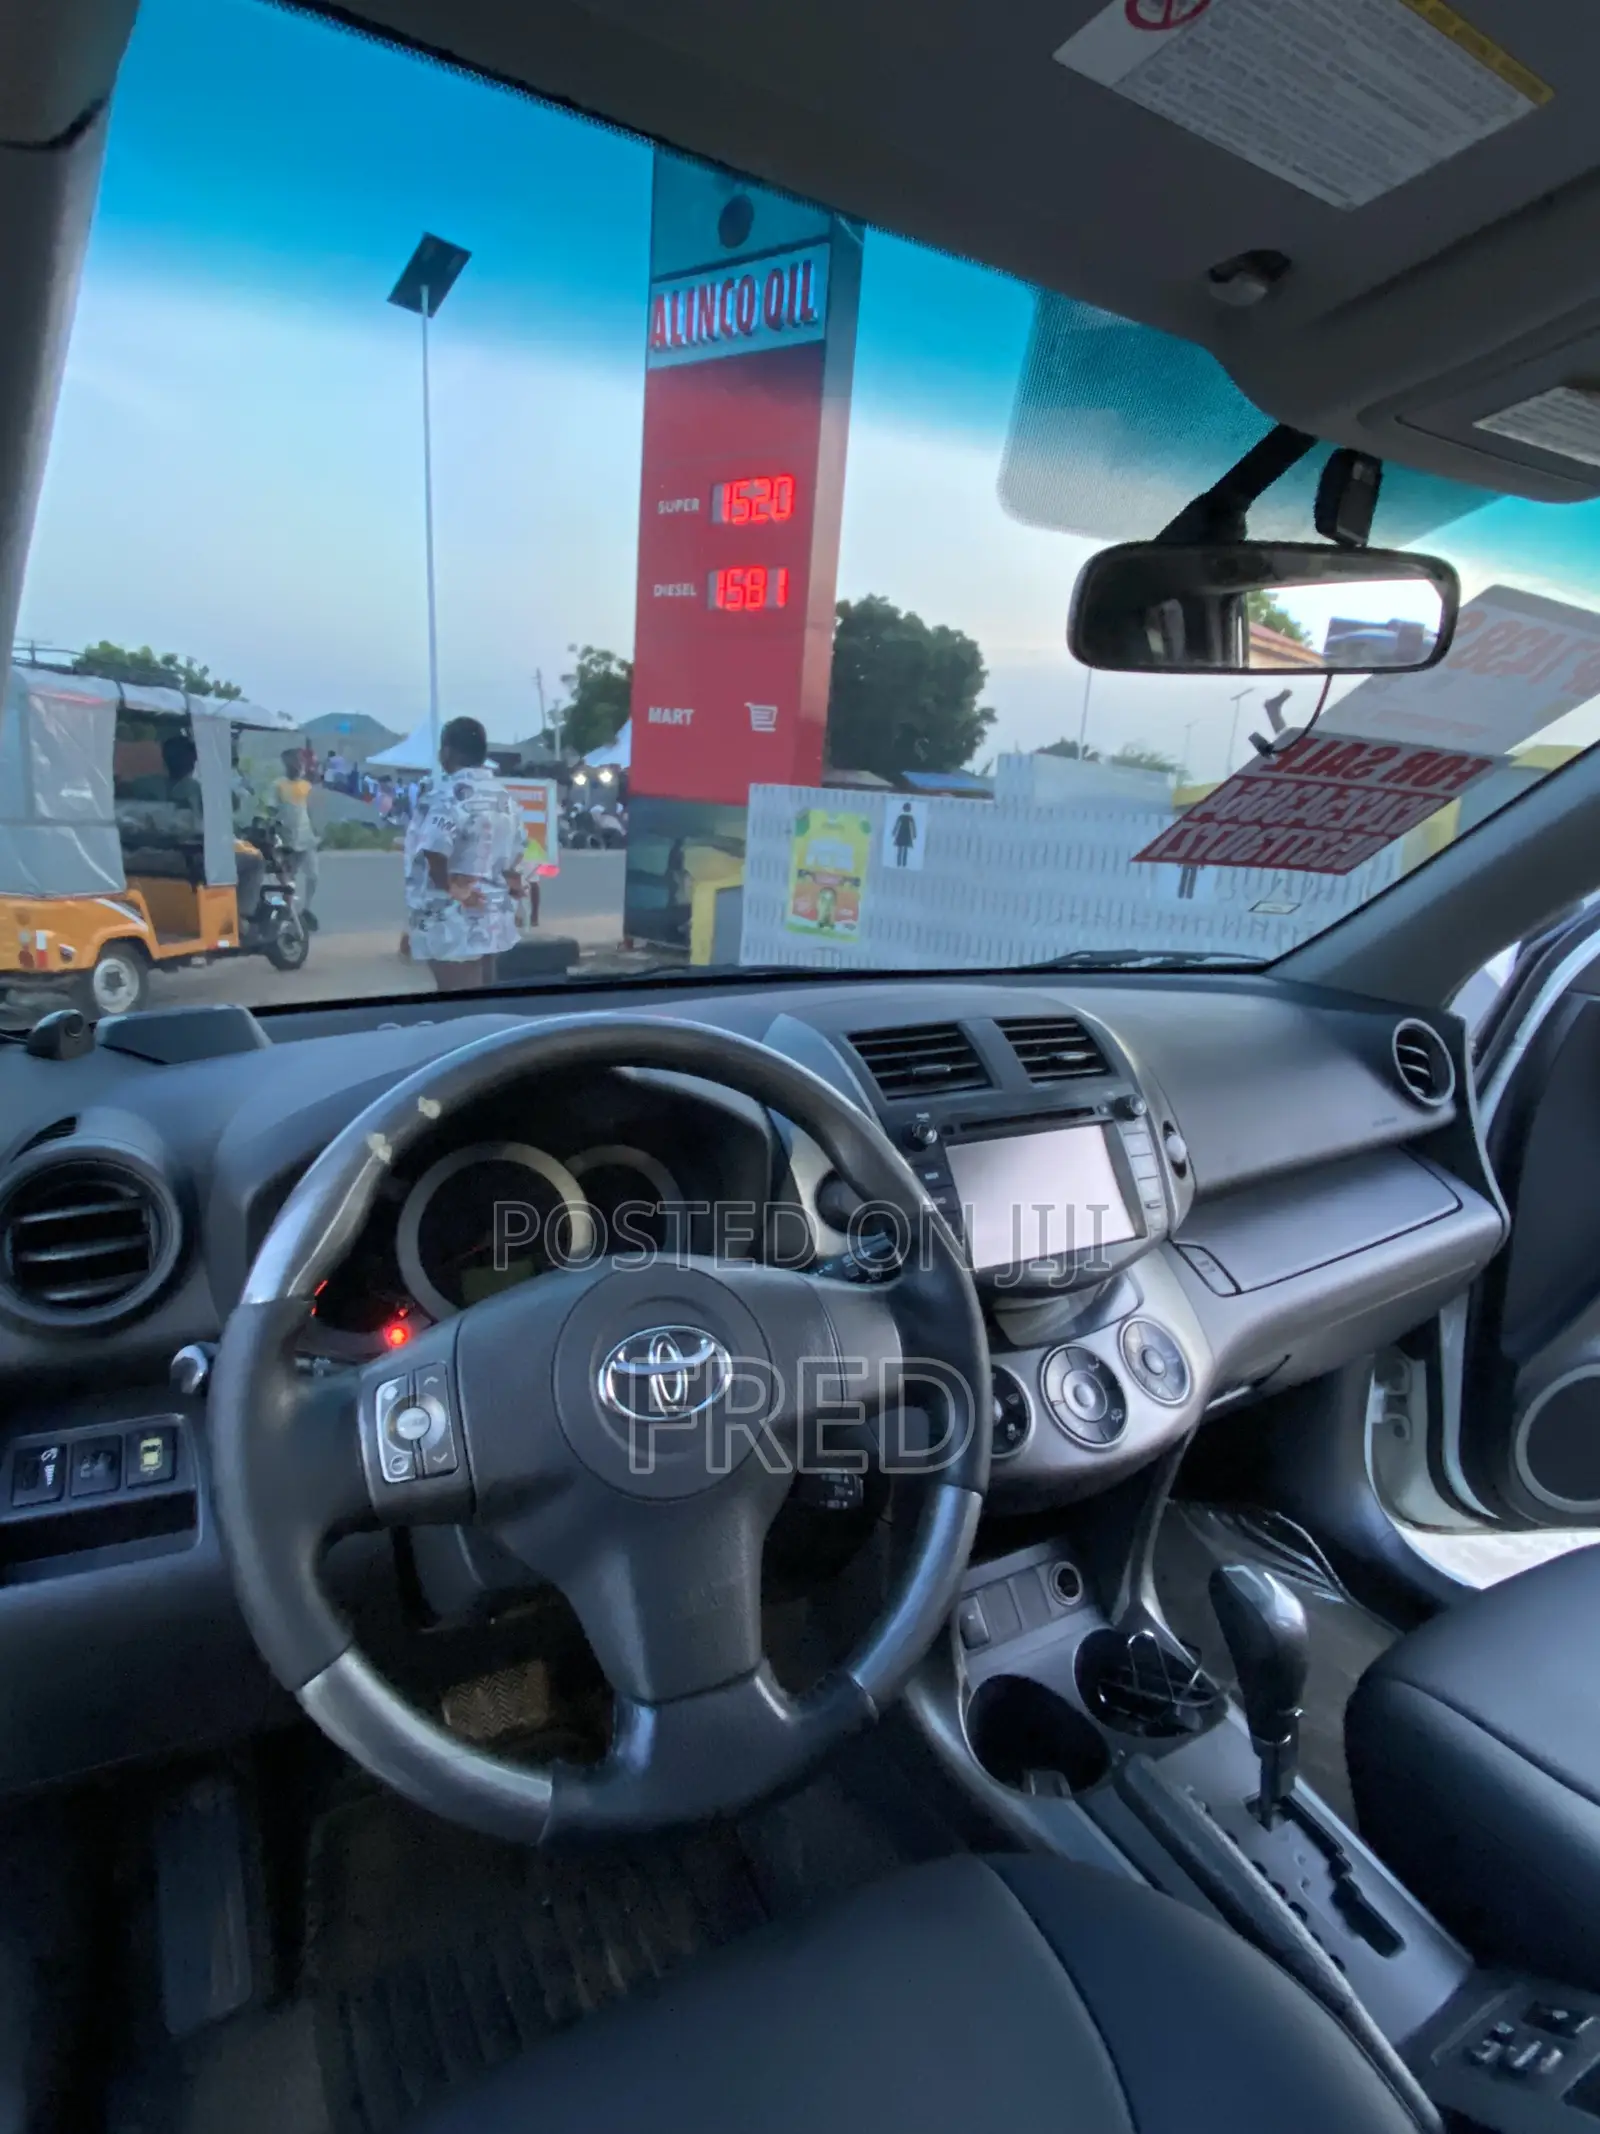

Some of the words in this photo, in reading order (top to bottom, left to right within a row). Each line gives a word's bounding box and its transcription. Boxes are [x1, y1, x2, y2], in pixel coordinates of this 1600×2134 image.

[650, 274, 759, 351] ALINCO
[763, 259, 818, 332] OIL
[658, 497, 701, 515] SUPER
[721, 472, 795, 525] 1520
[653, 582, 697, 598] DIESEL
[715, 565, 788, 612] 1581
[648, 706, 695, 726] MART
